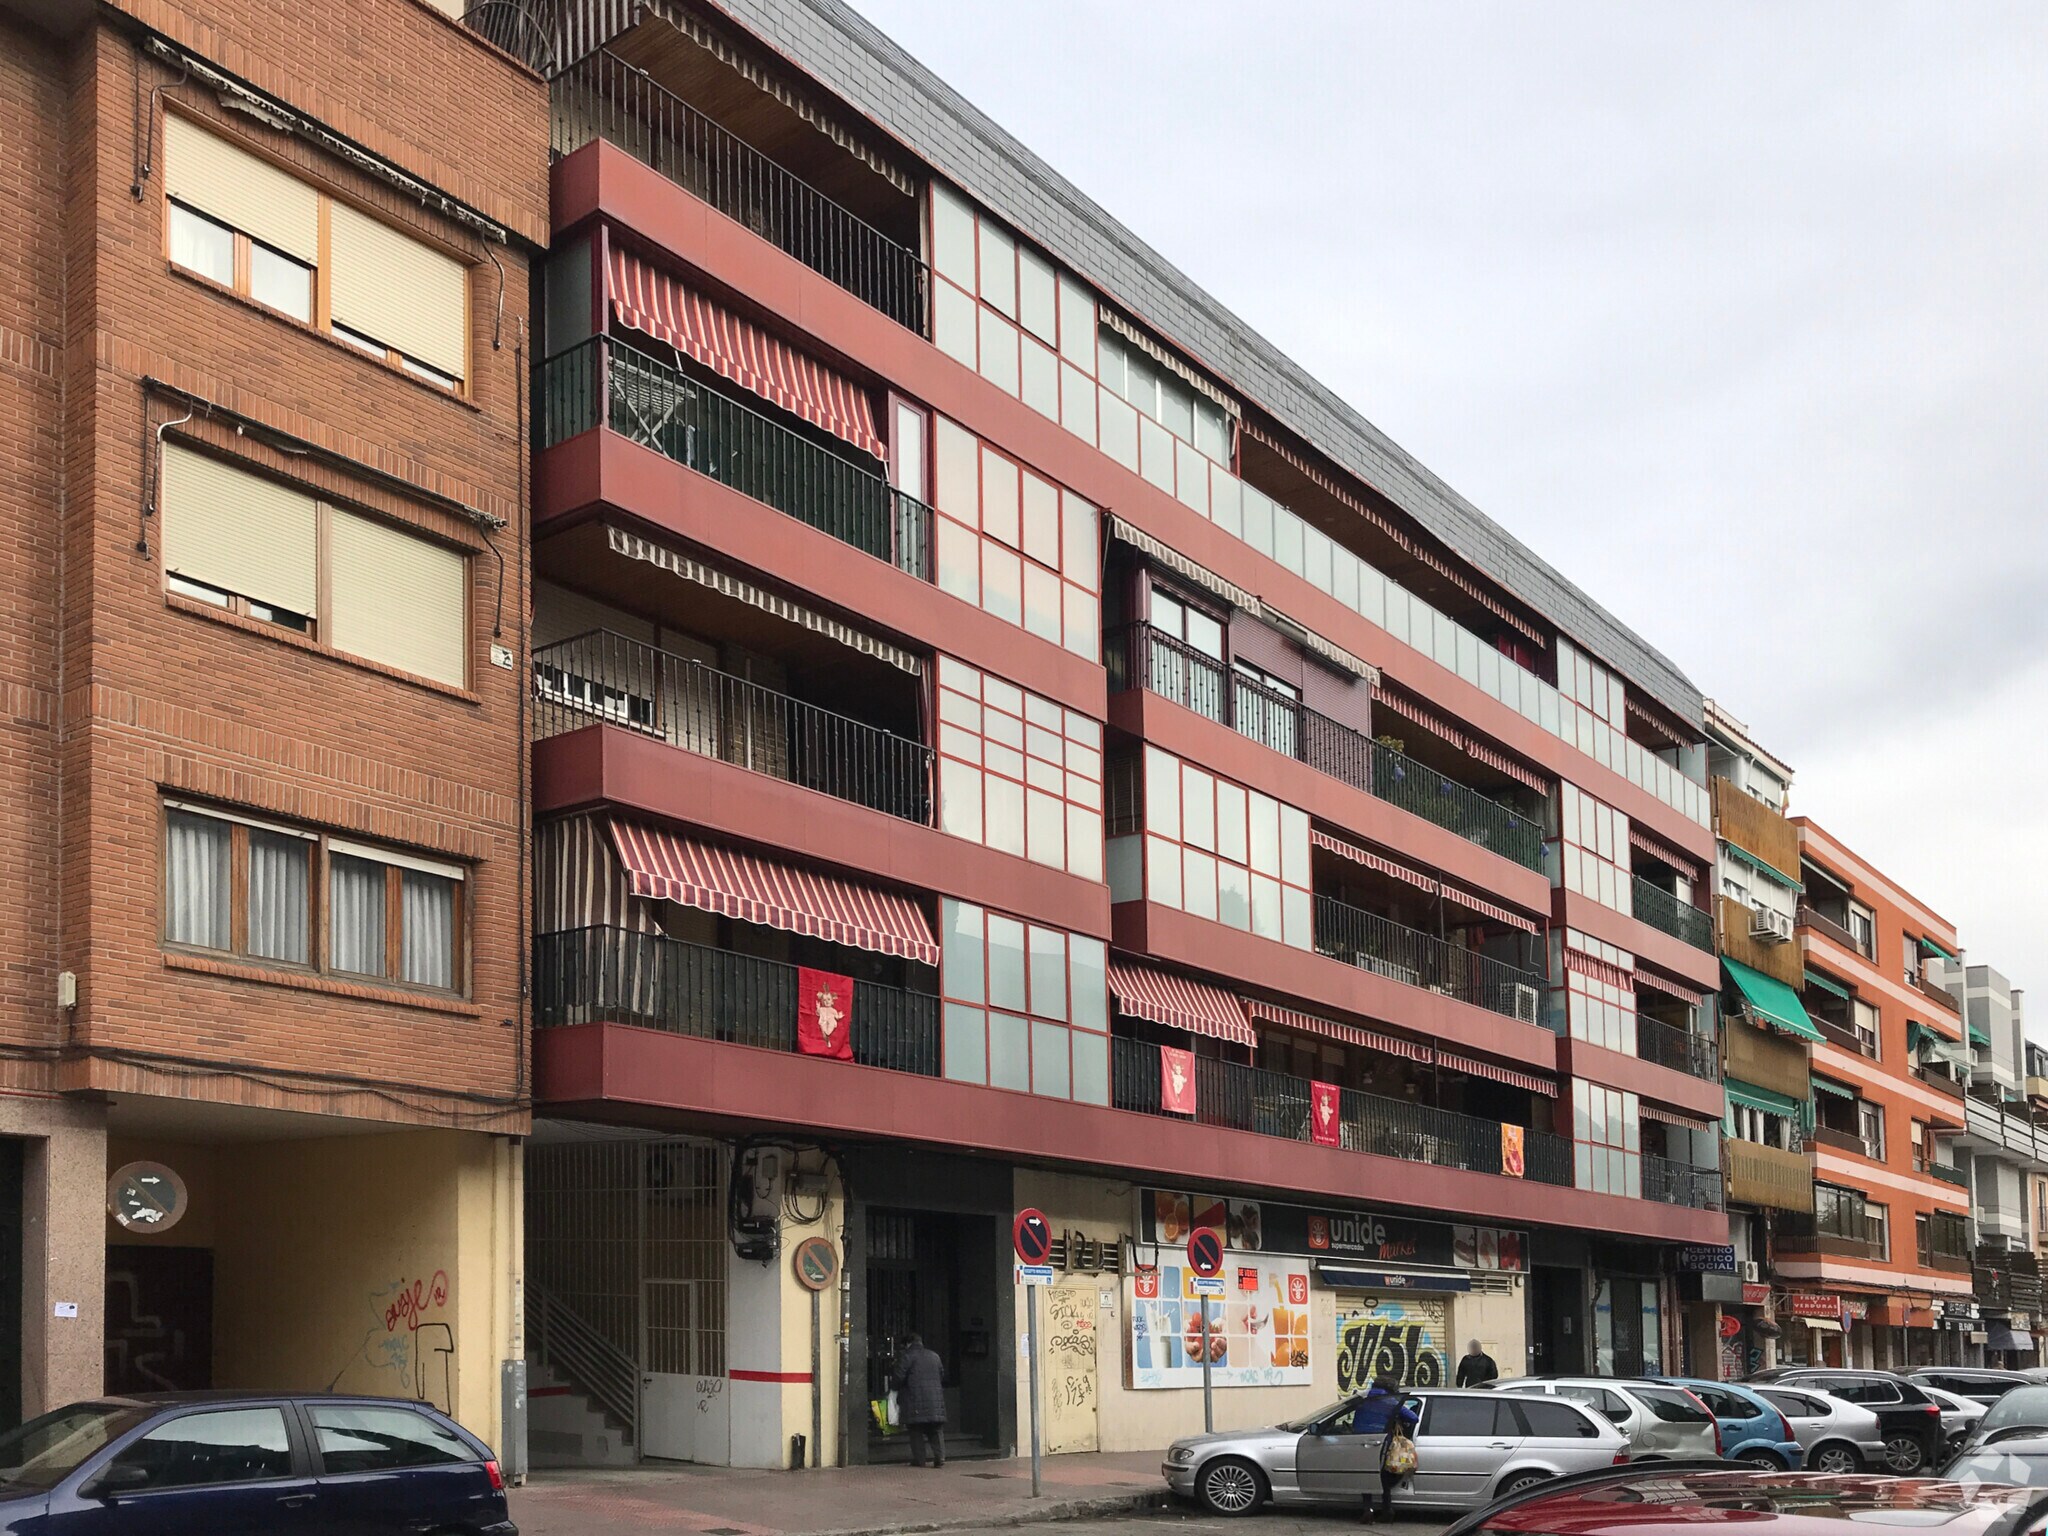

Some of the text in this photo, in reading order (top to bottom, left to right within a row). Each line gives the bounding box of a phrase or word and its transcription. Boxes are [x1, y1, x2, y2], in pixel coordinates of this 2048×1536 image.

[1330, 1214, 1386, 1245] unide
[1331, 1242, 1364, 1251] supermercados
[1690, 1254, 1733, 1262] OPTICO
[1690, 1262, 1733, 1270] SOCIAL
[1390, 1275, 1406, 1285] unide
